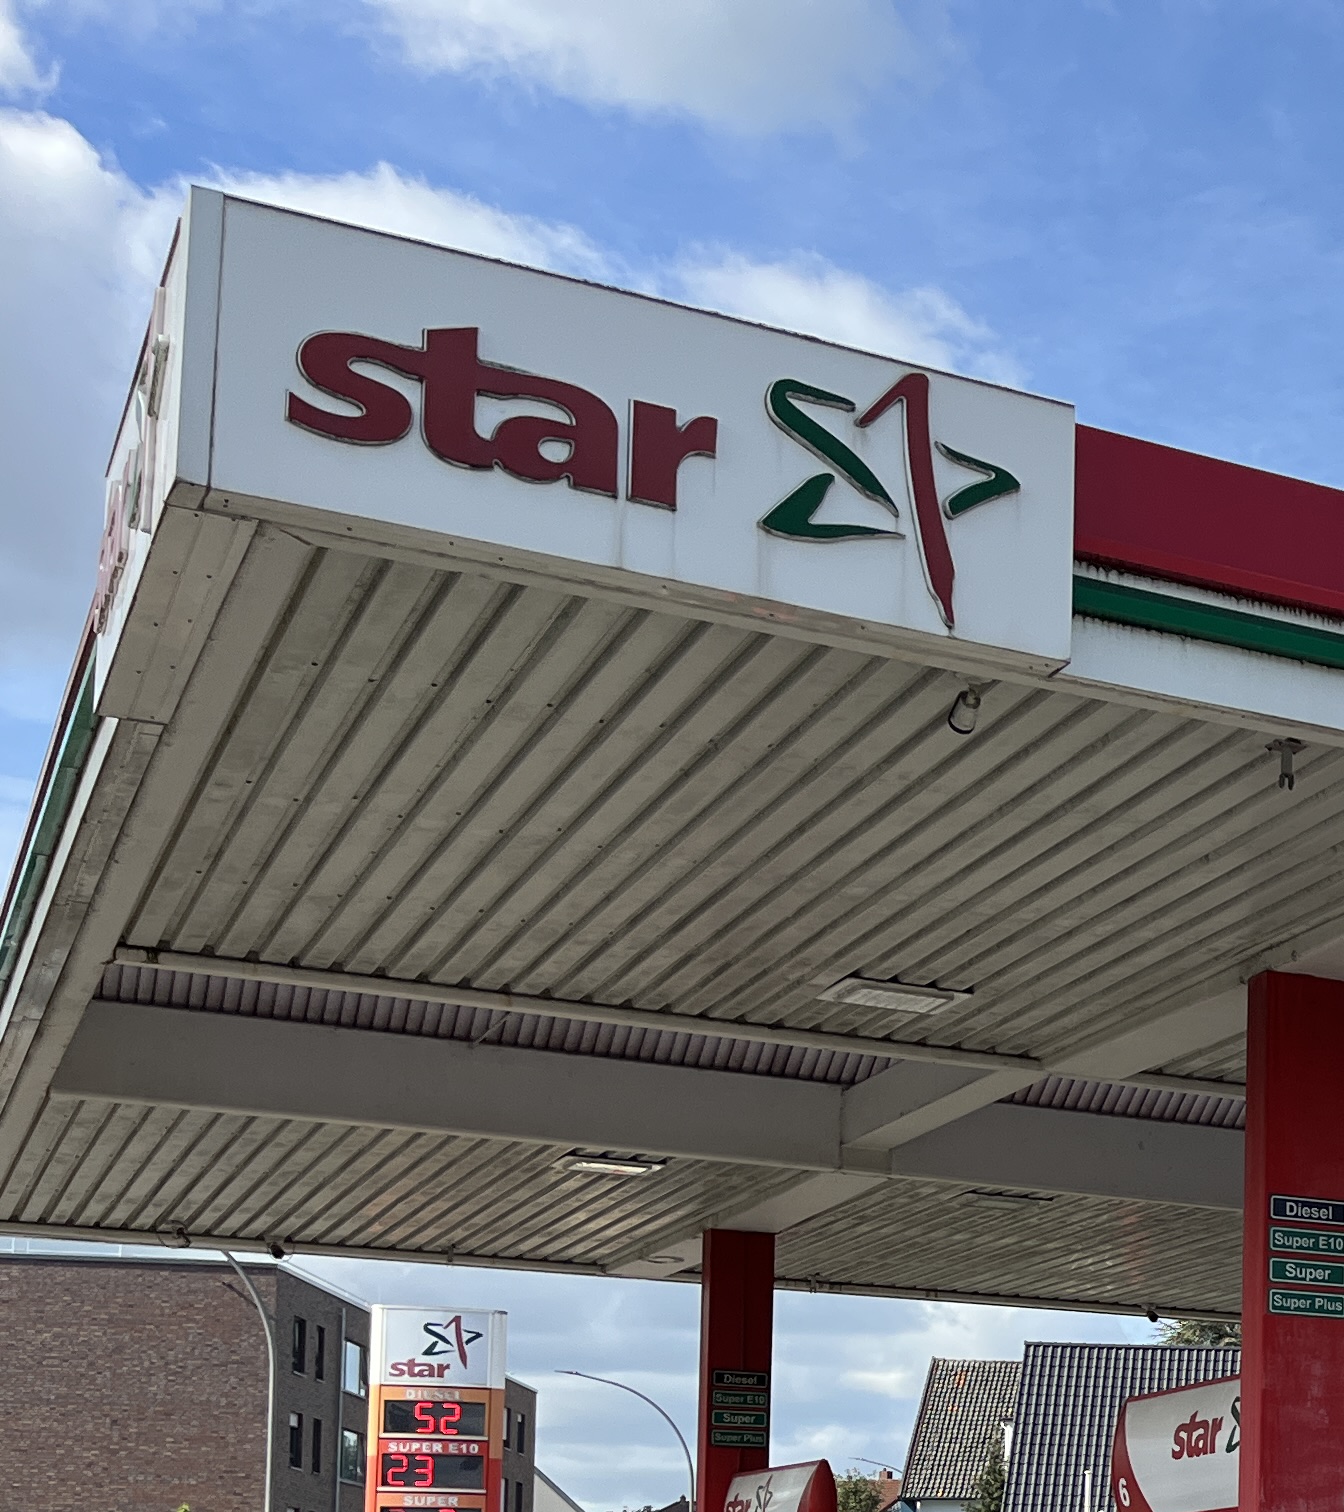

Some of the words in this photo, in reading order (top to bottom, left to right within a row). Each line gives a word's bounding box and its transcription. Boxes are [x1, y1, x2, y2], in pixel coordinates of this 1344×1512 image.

[284, 325, 718, 511] star
[1286, 1201, 1333, 1219] Diesel
[1274, 1232, 1315, 1249] Super
[1319, 1237, 1344, 1250] E10
[1285, 1263, 1331, 1281] Super
[1273, 1294, 1312, 1310] Super
[1315, 1298, 1343, 1311] Plus
[388, 1358, 451, 1379] star
[723, 1374, 758, 1385] Diesel
[723, 1412, 756, 1425] Super
[1171, 1410, 1224, 1461] star
[388, 1442, 443, 1453] SUPER
[449, 1443, 480, 1454] E10
[403, 1495, 459, 1507] SUPER
[1117, 1477, 1131, 1507] 6
